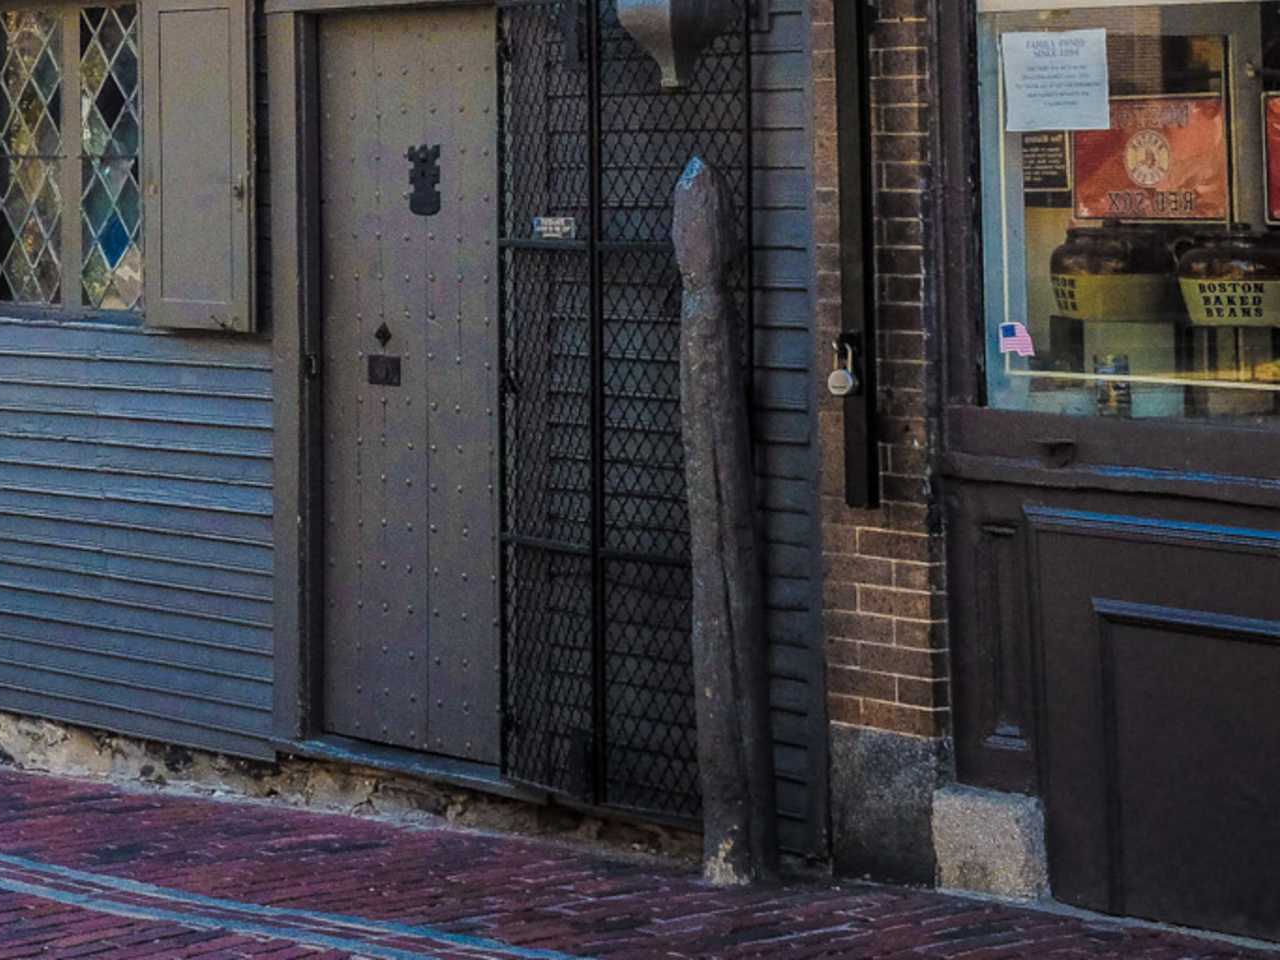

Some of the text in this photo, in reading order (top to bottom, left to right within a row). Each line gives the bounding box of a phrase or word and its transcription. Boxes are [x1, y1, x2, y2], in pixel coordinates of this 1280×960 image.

[1198, 282, 1265, 293] BOSTON
[1202, 295, 1262, 306] BAKED
[1205, 307, 1263, 317] BEANS
